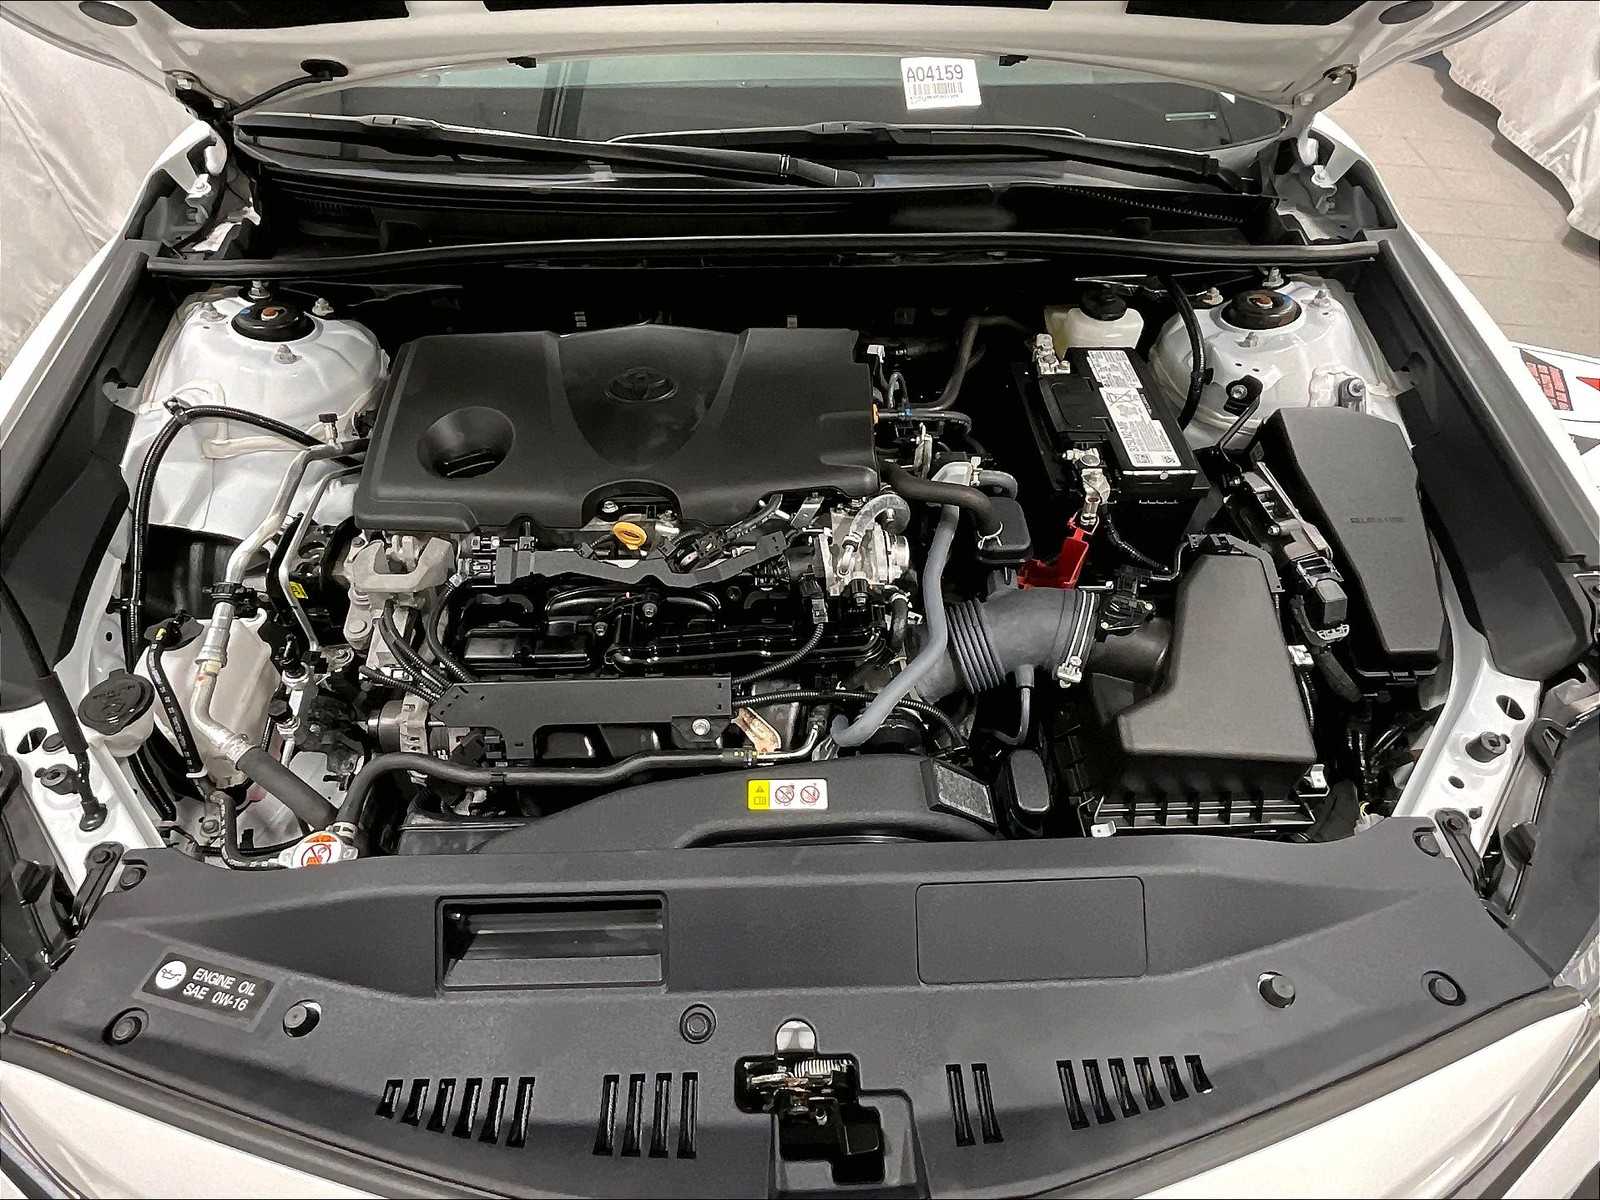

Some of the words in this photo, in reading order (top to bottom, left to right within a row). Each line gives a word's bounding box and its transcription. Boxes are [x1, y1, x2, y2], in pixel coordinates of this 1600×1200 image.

[906, 64, 964, 82] A04159
[192, 967, 236, 989] ENGINE
[237, 981, 256, 996] OIL
[182, 982, 210, 1000] SAE
[211, 991, 249, 1011] 0W-16
